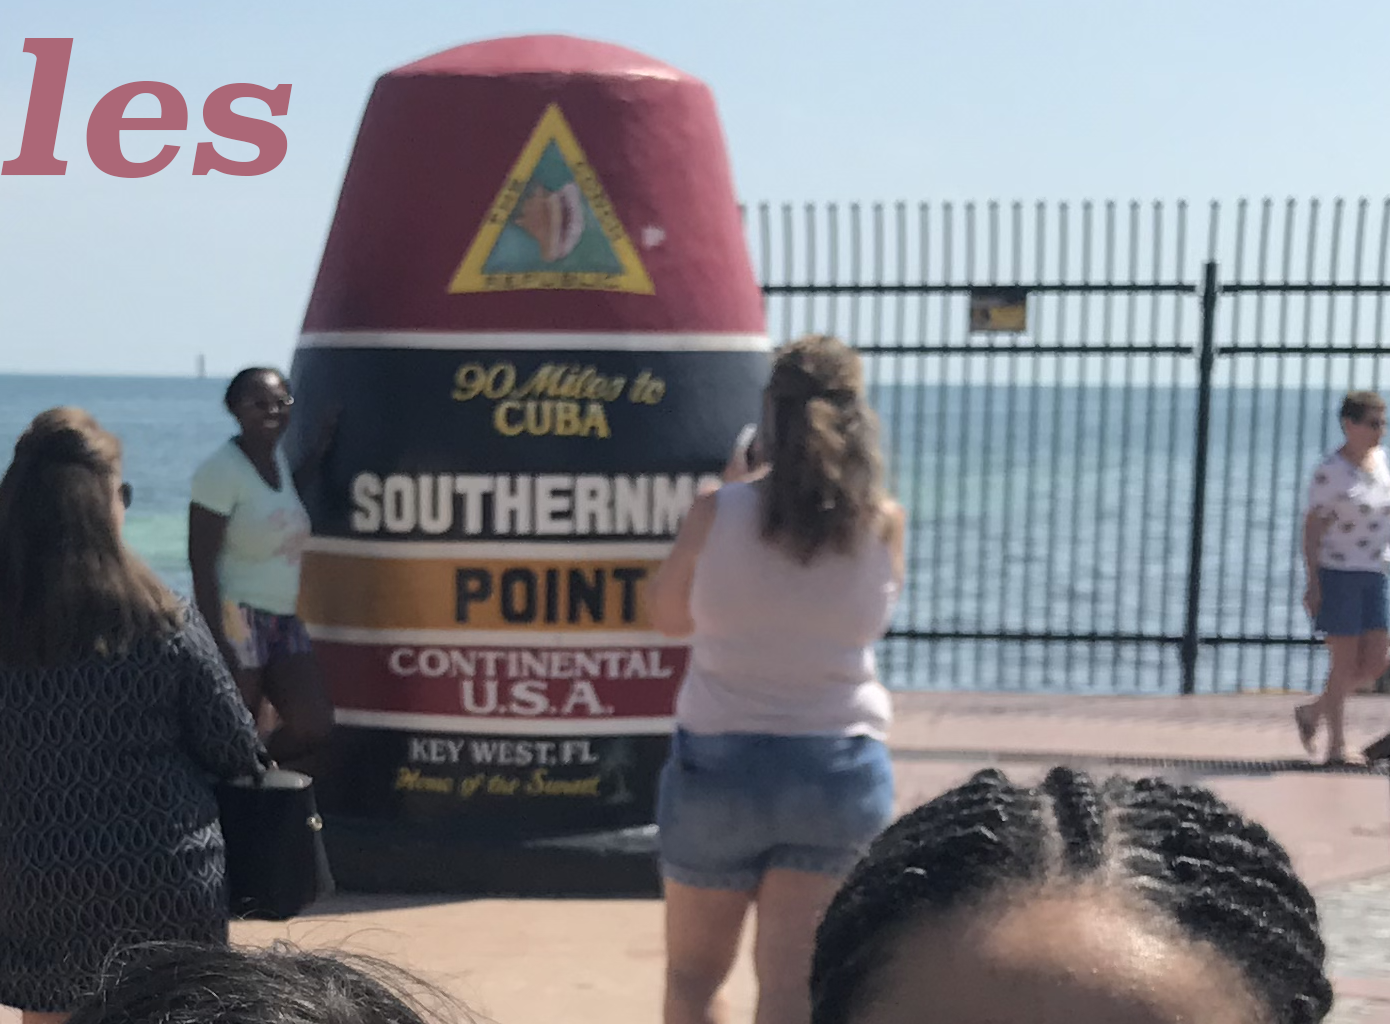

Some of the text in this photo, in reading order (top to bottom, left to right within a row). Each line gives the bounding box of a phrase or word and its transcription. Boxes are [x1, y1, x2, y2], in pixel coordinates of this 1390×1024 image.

[450, 361, 666, 405] 90 Miles to
[493, 400, 611, 438] CUBA
[348, 471, 722, 536] SOUTHERNM
[454, 567, 647, 624] POINT
[389, 648, 675, 679] CONTINENTAL
[460, 678, 615, 716] U.S.A.
[410, 737, 465, 763] KEY
